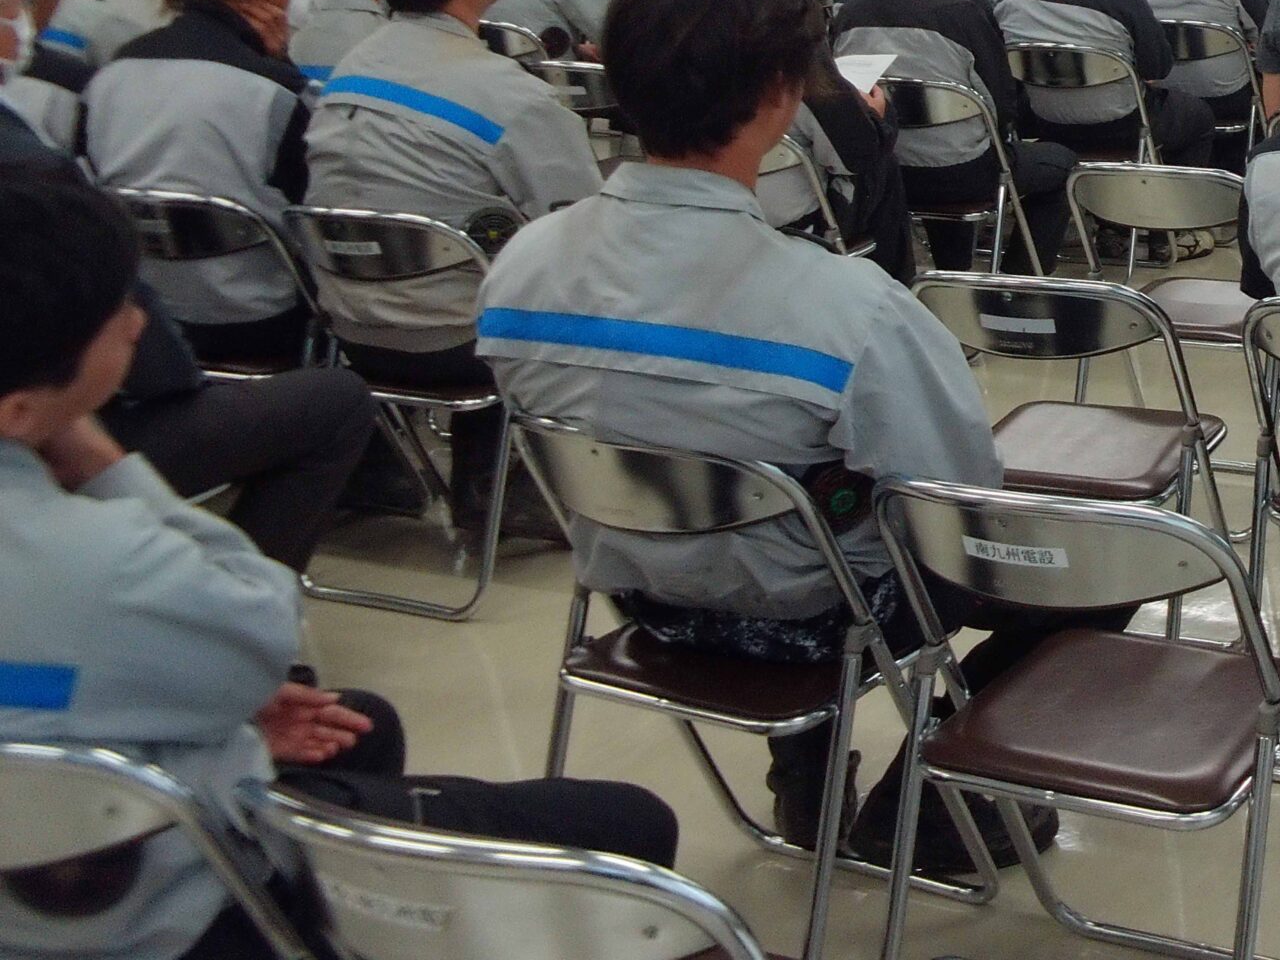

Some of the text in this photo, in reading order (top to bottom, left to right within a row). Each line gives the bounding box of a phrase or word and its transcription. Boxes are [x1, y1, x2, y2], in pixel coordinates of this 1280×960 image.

[975, 541, 1056, 565] 南九州電設
